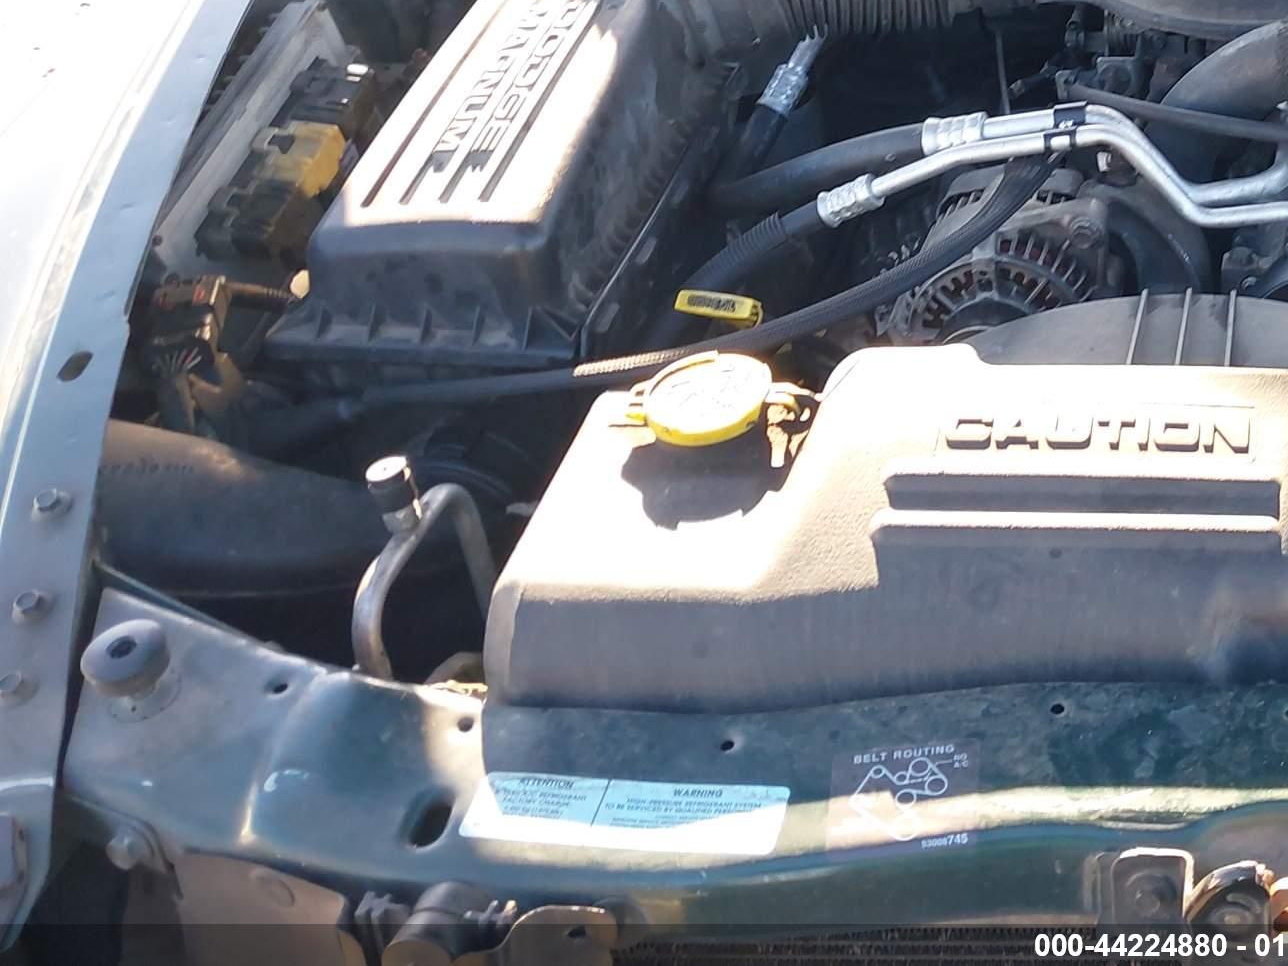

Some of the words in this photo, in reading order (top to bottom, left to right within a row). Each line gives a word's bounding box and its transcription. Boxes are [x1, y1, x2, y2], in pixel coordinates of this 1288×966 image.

[945, 416, 1251, 453] CAUTION
[853, 752, 887, 765] BELT
[893, 744, 955, 759] ROUTING
[519, 777, 576, 789] ATTENTION
[672, 788, 724, 798] WARNING
